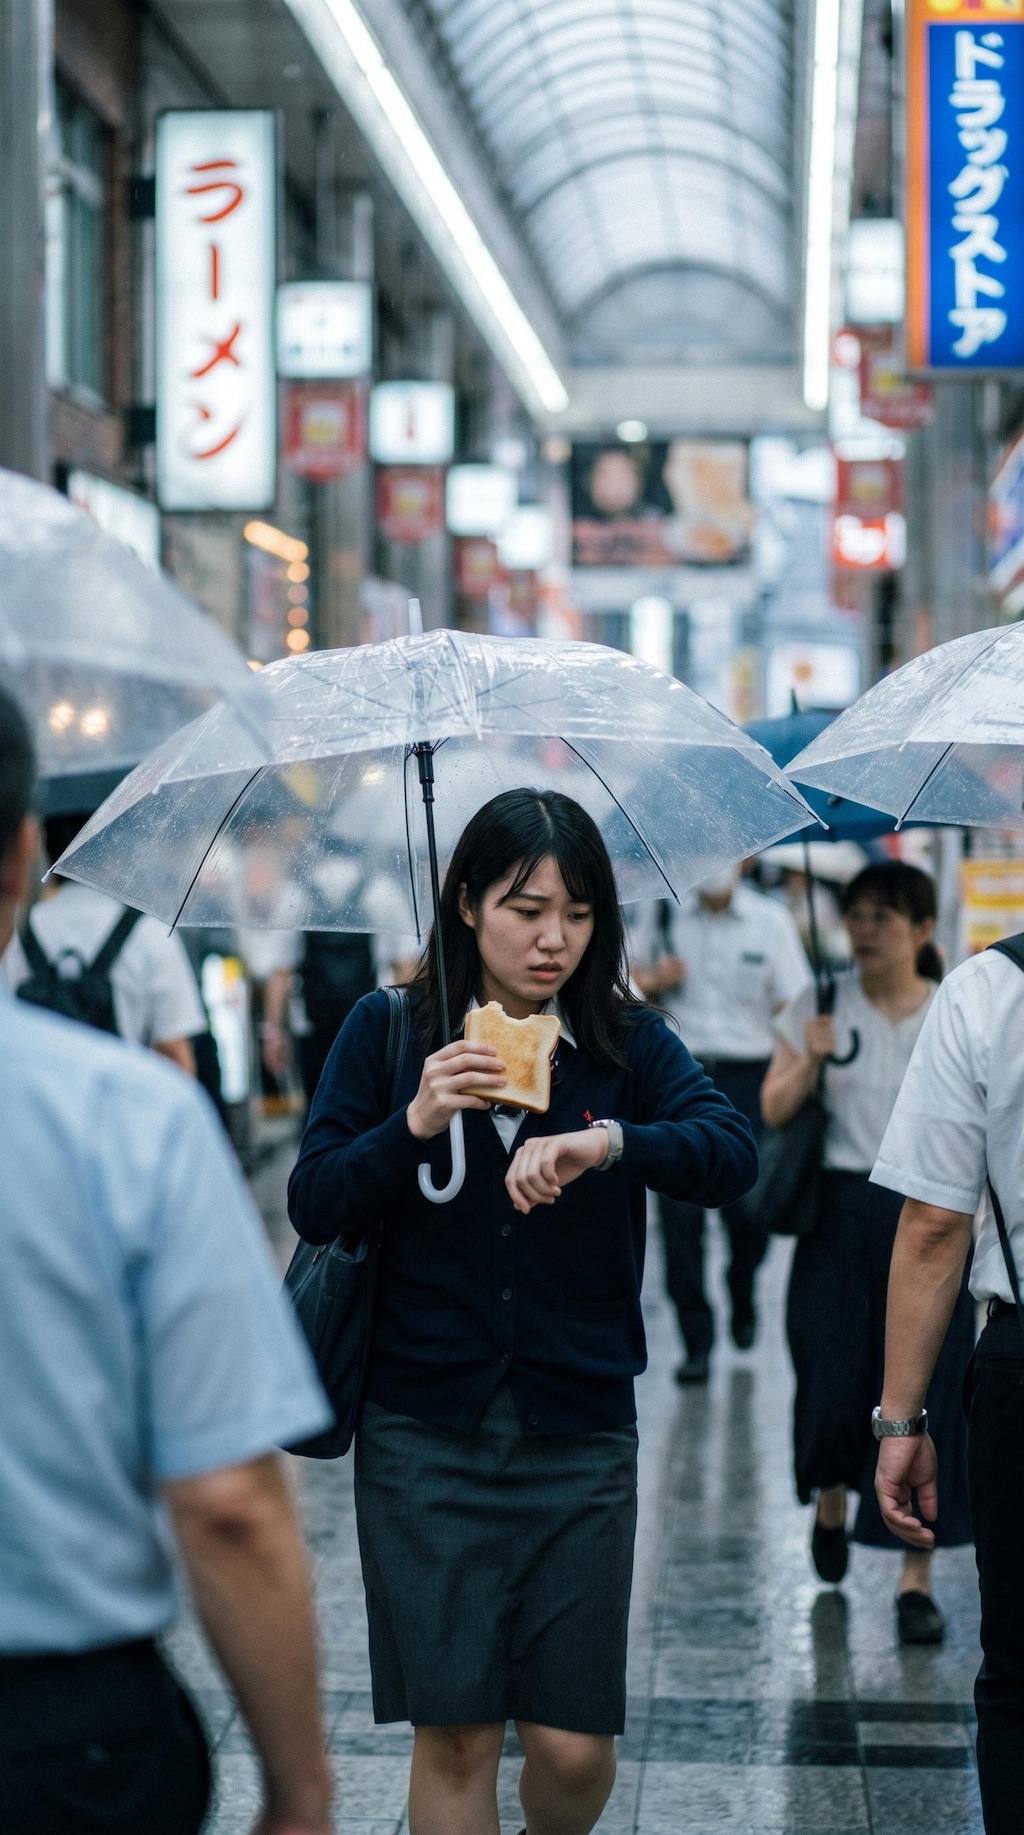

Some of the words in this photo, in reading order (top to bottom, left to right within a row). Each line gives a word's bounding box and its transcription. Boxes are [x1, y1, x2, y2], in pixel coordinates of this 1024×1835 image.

[184, 160, 244, 460] ラーメン
[947, 29, 1010, 358] ドラッグストア
